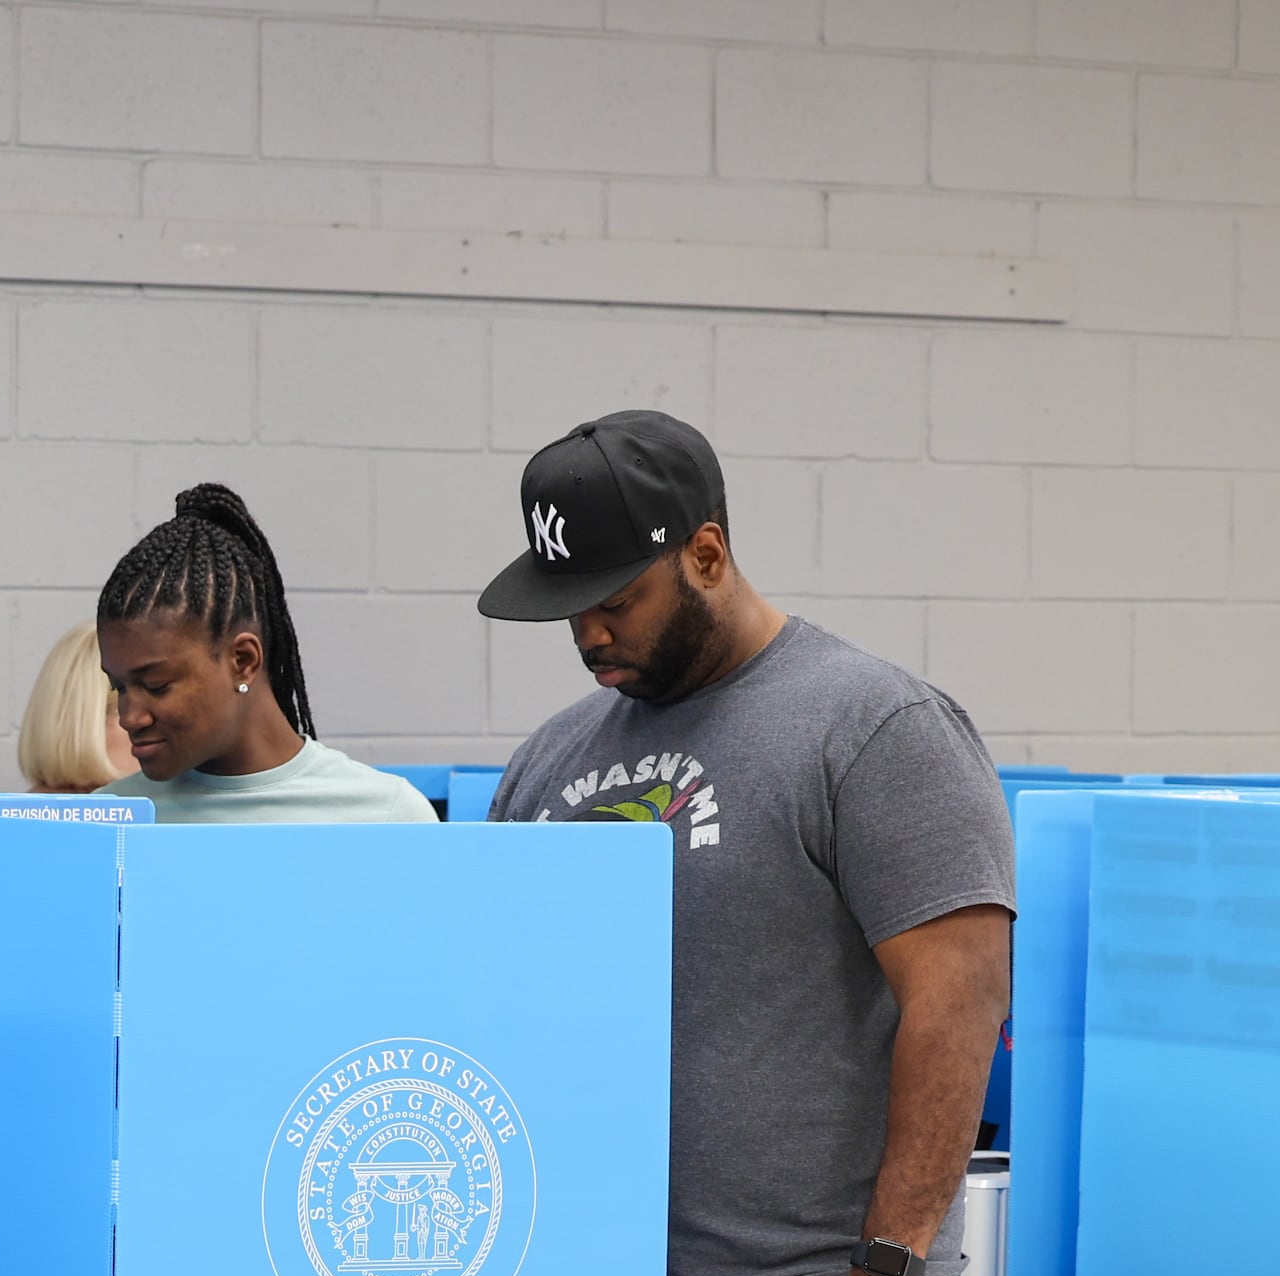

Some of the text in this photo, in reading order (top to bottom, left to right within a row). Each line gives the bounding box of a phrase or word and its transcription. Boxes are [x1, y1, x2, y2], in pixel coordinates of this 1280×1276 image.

[531, 501, 571, 561] NY
[63, 808, 81, 822] DE
[83, 807, 134, 822] BOLETA
[560, 752, 720, 850] WASN'T ME
[286, 1049, 518, 1148] SECRETARY OF STATE
[310, 1092, 492, 1221] STATE OF GEORGIA
[366, 1125, 442, 1156] CONSTITUTION
[384, 1188, 421, 1201] JUSTICE
[432, 1191, 461, 1211] MODER
